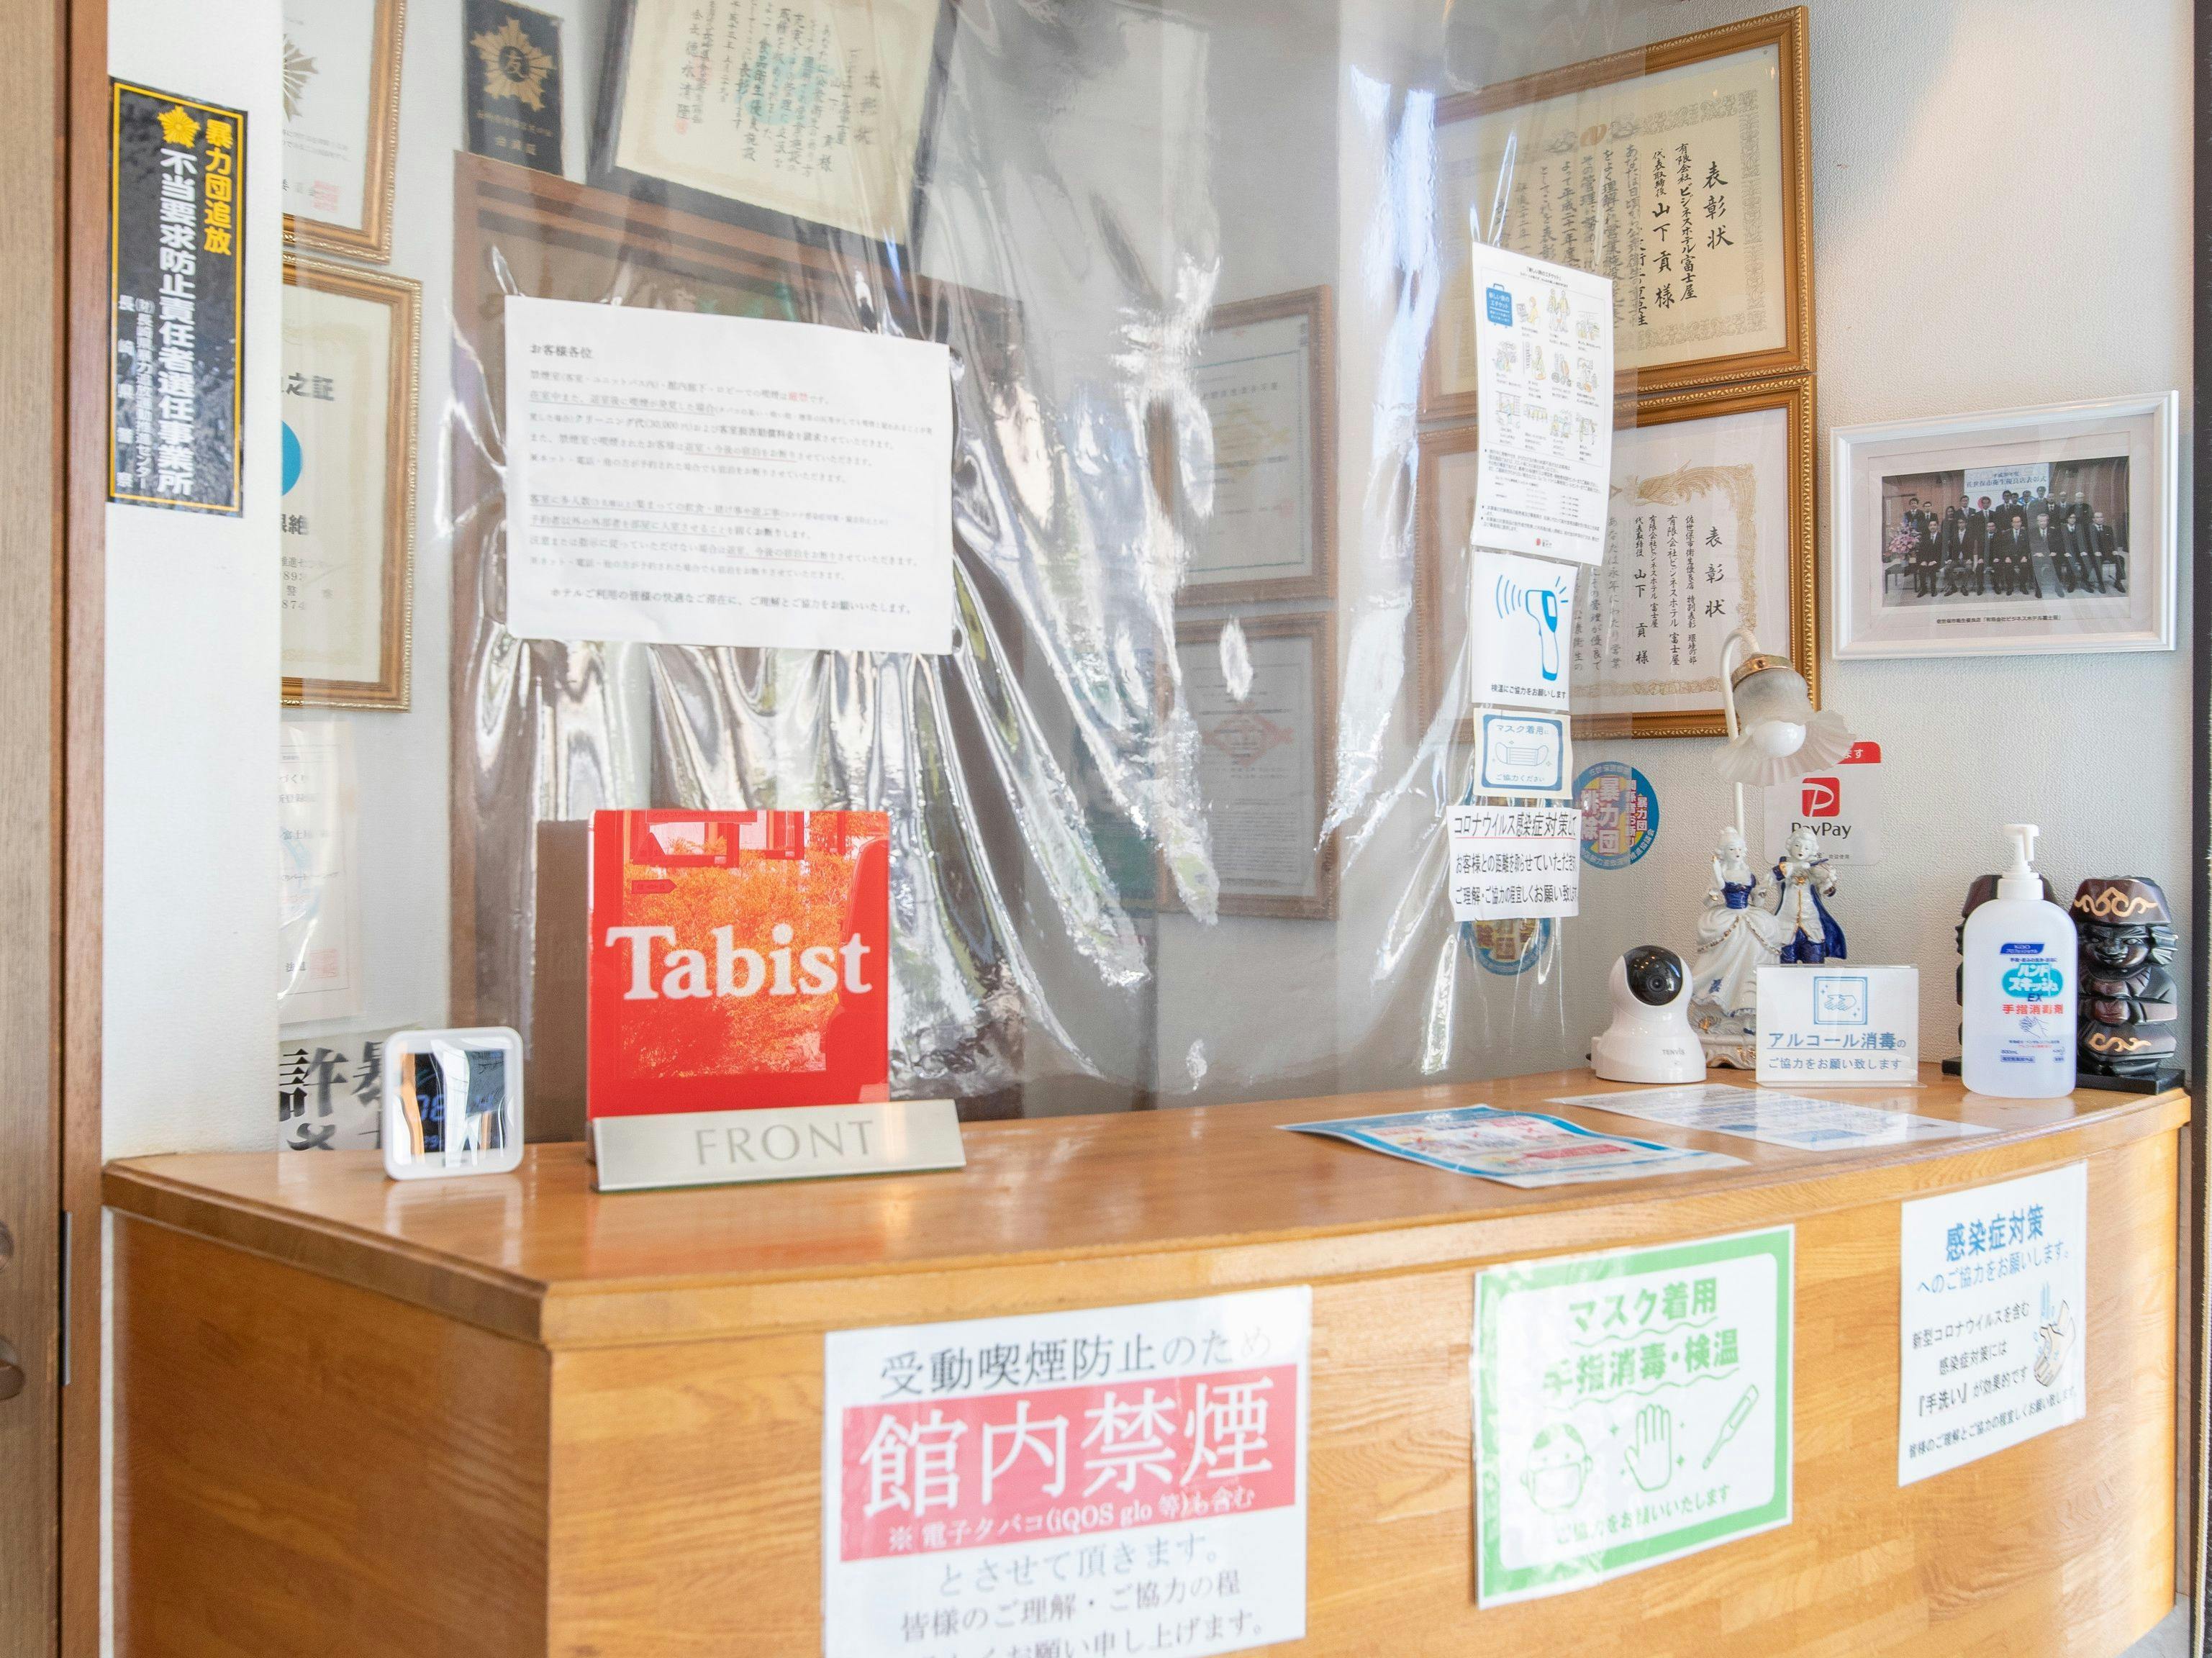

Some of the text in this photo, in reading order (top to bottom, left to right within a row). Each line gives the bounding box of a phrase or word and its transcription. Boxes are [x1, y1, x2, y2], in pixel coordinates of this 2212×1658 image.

[204, 119, 232, 255] 暴力団追放
[1703, 160, 1735, 250] 表彰状
[1675, 142, 1698, 302] 有限会社ビジネスホテル富士屋
[157, 147, 197, 497] 不当要求防止責任者選任事業所
[530, 343, 593, 360] お客様各位
[281, 371, 335, 402] 之証
[1634, 568, 1647, 598] 山下
[1667, 515, 1681, 666] 有限会社ビジネスホテル 富士屋
[1705, 526, 1726, 618] 表彰状
[1650, 602, 1659, 628] 富士屋
[1636, 650, 1650, 665] 様
[1491, 684, 1567, 700] 検温にご協力をお願いします
[1496, 723, 1549, 735] マスク着用に
[1496, 773, 1546, 784] ご協力ください
[1599, 776, 1621, 854] 暴力団
[1636, 796, 1649, 832] 暴力団
[604, 923, 874, 1001] Tabist
[2008, 977, 2059, 992] スキッシュ
[2017, 964, 2051, 978] ハンド
[2002, 1004, 2064, 1015] 手指消毒剤
[2027, 993, 2043, 1002] EX
[1768, 1031, 1906, 1049] アルコール消毒の
[1768, 1056, 1902, 1070] ご協力をお願い致します
[695, 1119, 875, 1166] FRONT
[1945, 1202, 2045, 1263] 感染症対策
[1916, 1240, 2070, 1294] へのご協力をお願いします。
[1568, 1277, 1719, 1332] マスク着用
[1913, 1301, 2031, 1351] 新型コロナウイルスを含む
[879, 1326, 1273, 1400] 受動喫煙防止のため
[1939, 1341, 2009, 1377] 感染症対策には
[859, 1374, 1276, 1521] 館内禁煙
[940, 1536, 1220, 1599] とさせて頂きます。
[899, 1567, 1243, 1645] 皆様のご理解・ご協力の程
